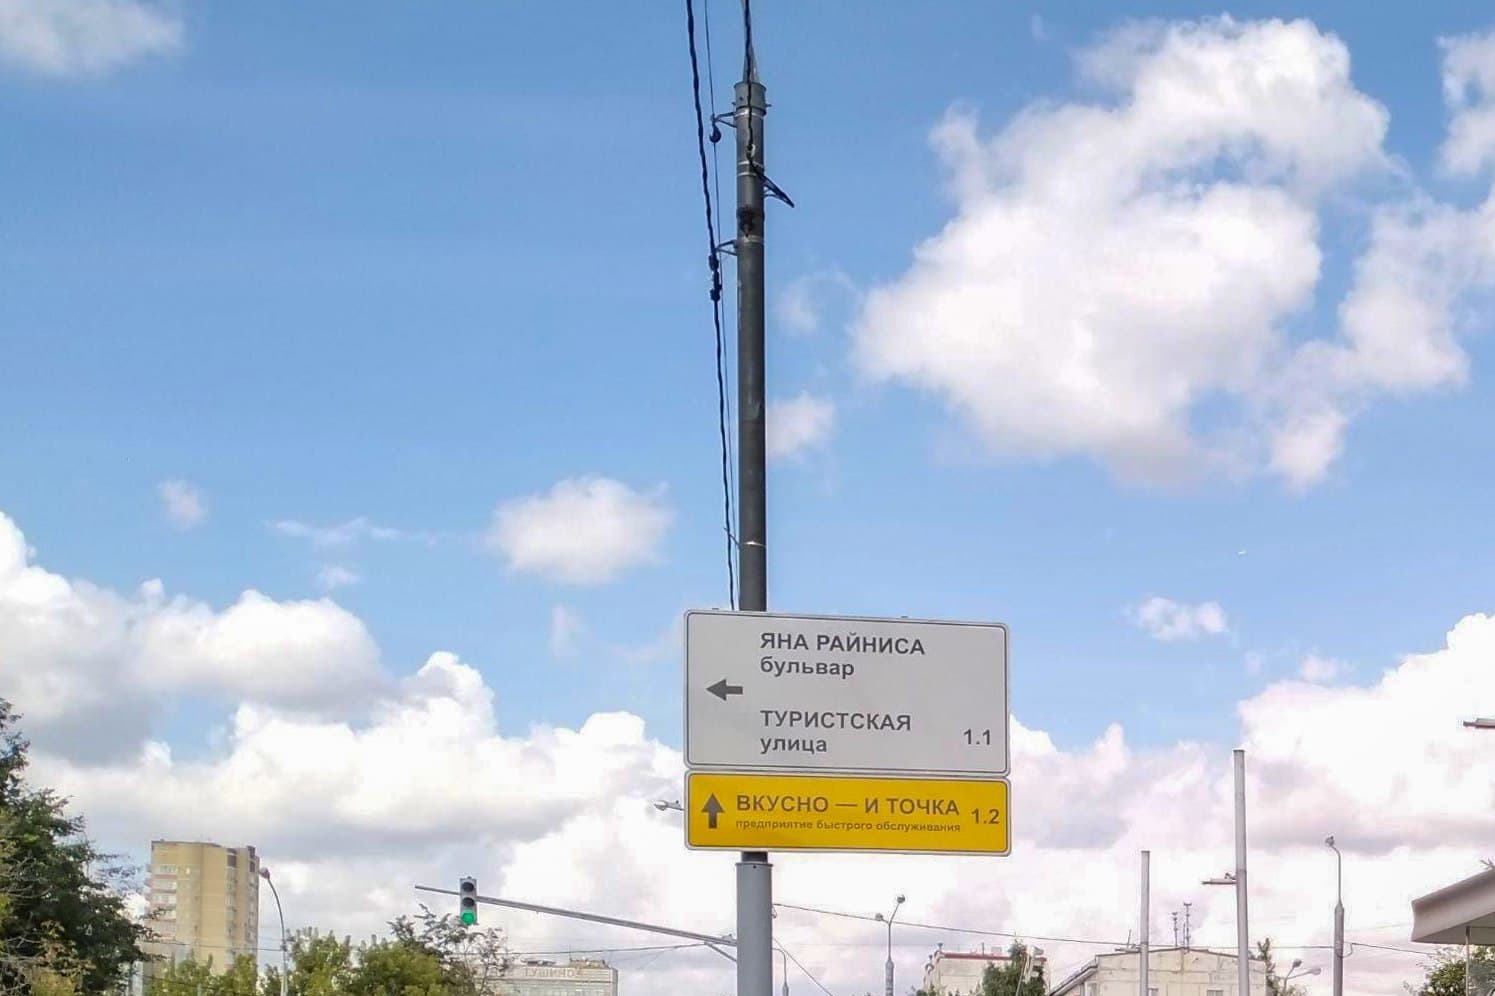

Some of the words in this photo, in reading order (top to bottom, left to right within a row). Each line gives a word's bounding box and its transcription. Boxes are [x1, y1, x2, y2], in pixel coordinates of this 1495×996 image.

[760, 632, 809, 650] ЯНА
[816, 632, 925, 655] РАЙНИСА
[760, 656, 855, 679] бульвар
[760, 710, 911, 731] ТУРИСТСКАЯ
[760, 736, 828, 754] улица
[963, 730, 991, 746] 1.1
[736, 794, 829, 813] ВКУСНО
[865, 797, 879, 814] И
[887, 798, 960, 816] ТОЧКА
[971, 808, 999, 825] 1.2
[736, 819, 813, 831] предприятие
[816, 820, 873, 833] быстрого
[876, 821, 961, 834] обслуживания
